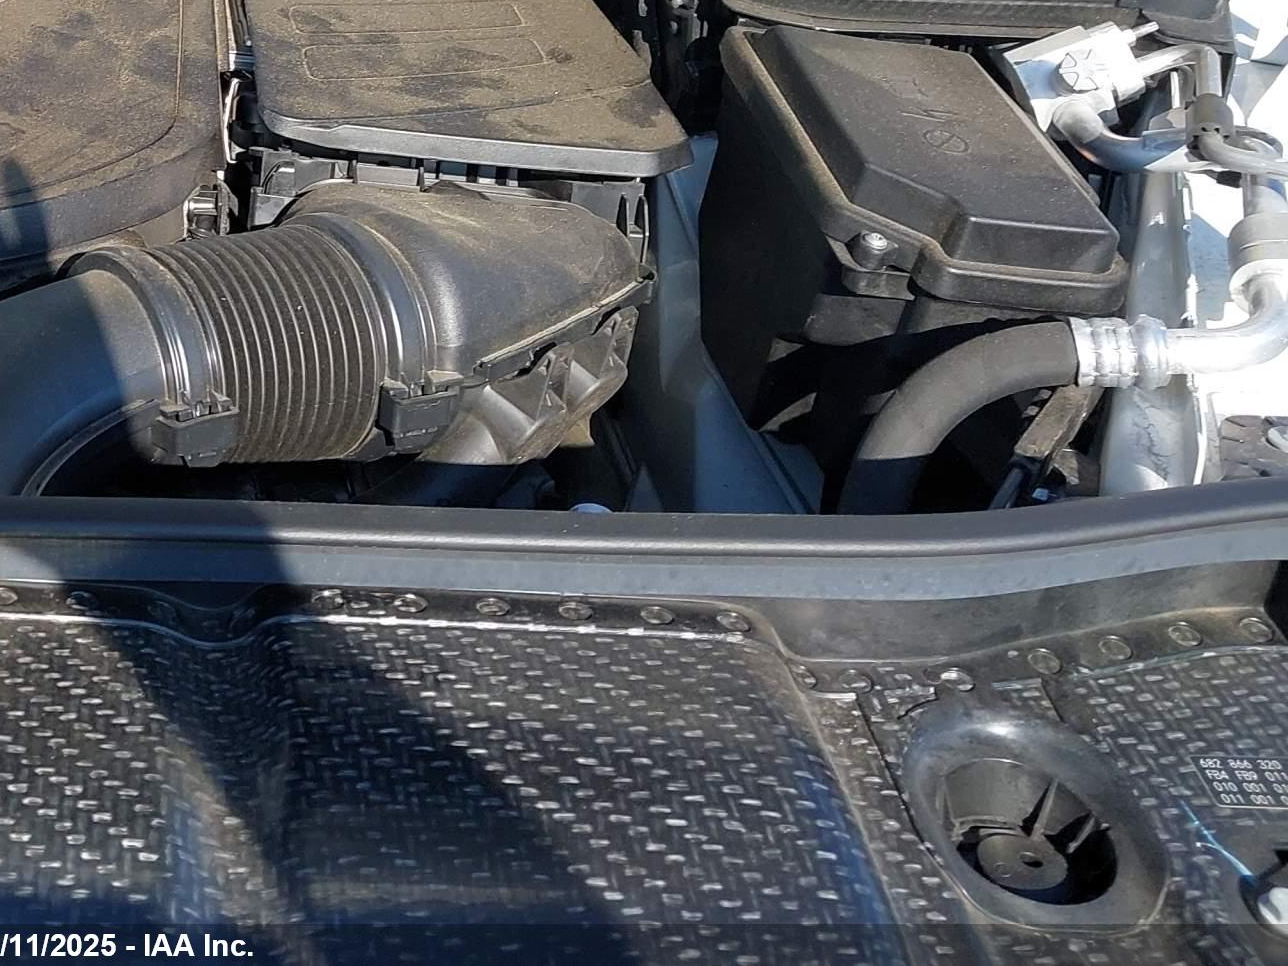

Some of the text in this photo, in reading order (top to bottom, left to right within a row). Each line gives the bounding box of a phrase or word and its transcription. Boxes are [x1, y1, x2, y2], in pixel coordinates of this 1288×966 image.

[1200, 758, 1283, 770] 682 866 320
[1205, 769, 1230, 780] FB4
[1234, 770, 1258, 780] FB9
[1212, 781, 1238, 792] 010
[1242, 782, 1267, 792] 001
[1220, 793, 1246, 803] 011
[1250, 794, 1275, 804] 001
